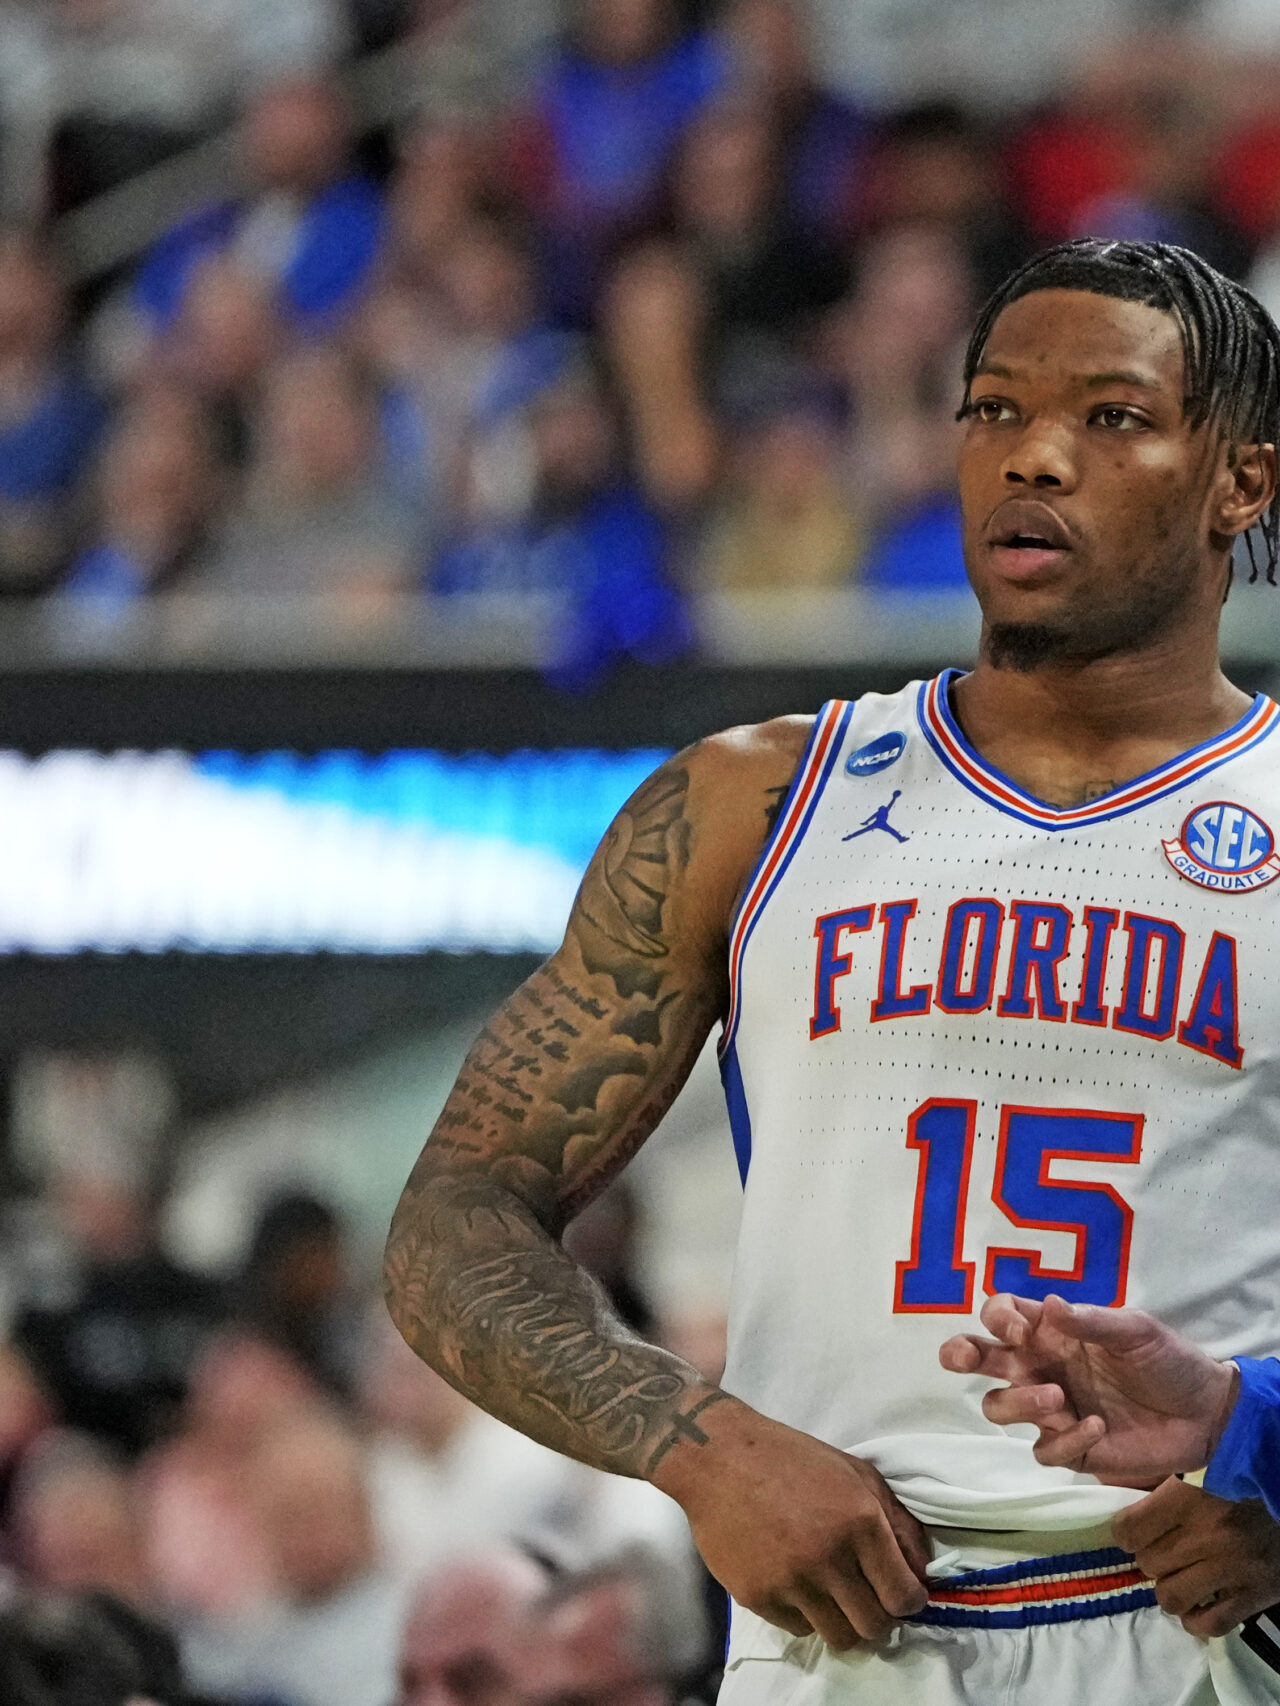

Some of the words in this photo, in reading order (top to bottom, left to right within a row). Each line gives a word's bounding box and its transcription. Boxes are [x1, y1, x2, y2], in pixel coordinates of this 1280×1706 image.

[852, 747, 900, 767] NCAA
[1191, 806, 1266, 868] SEC
[1173, 856, 1270, 889] GRADUATE
[809, 897, 1244, 1070] FLORIDA
[893, 1097, 1145, 1314] 15
